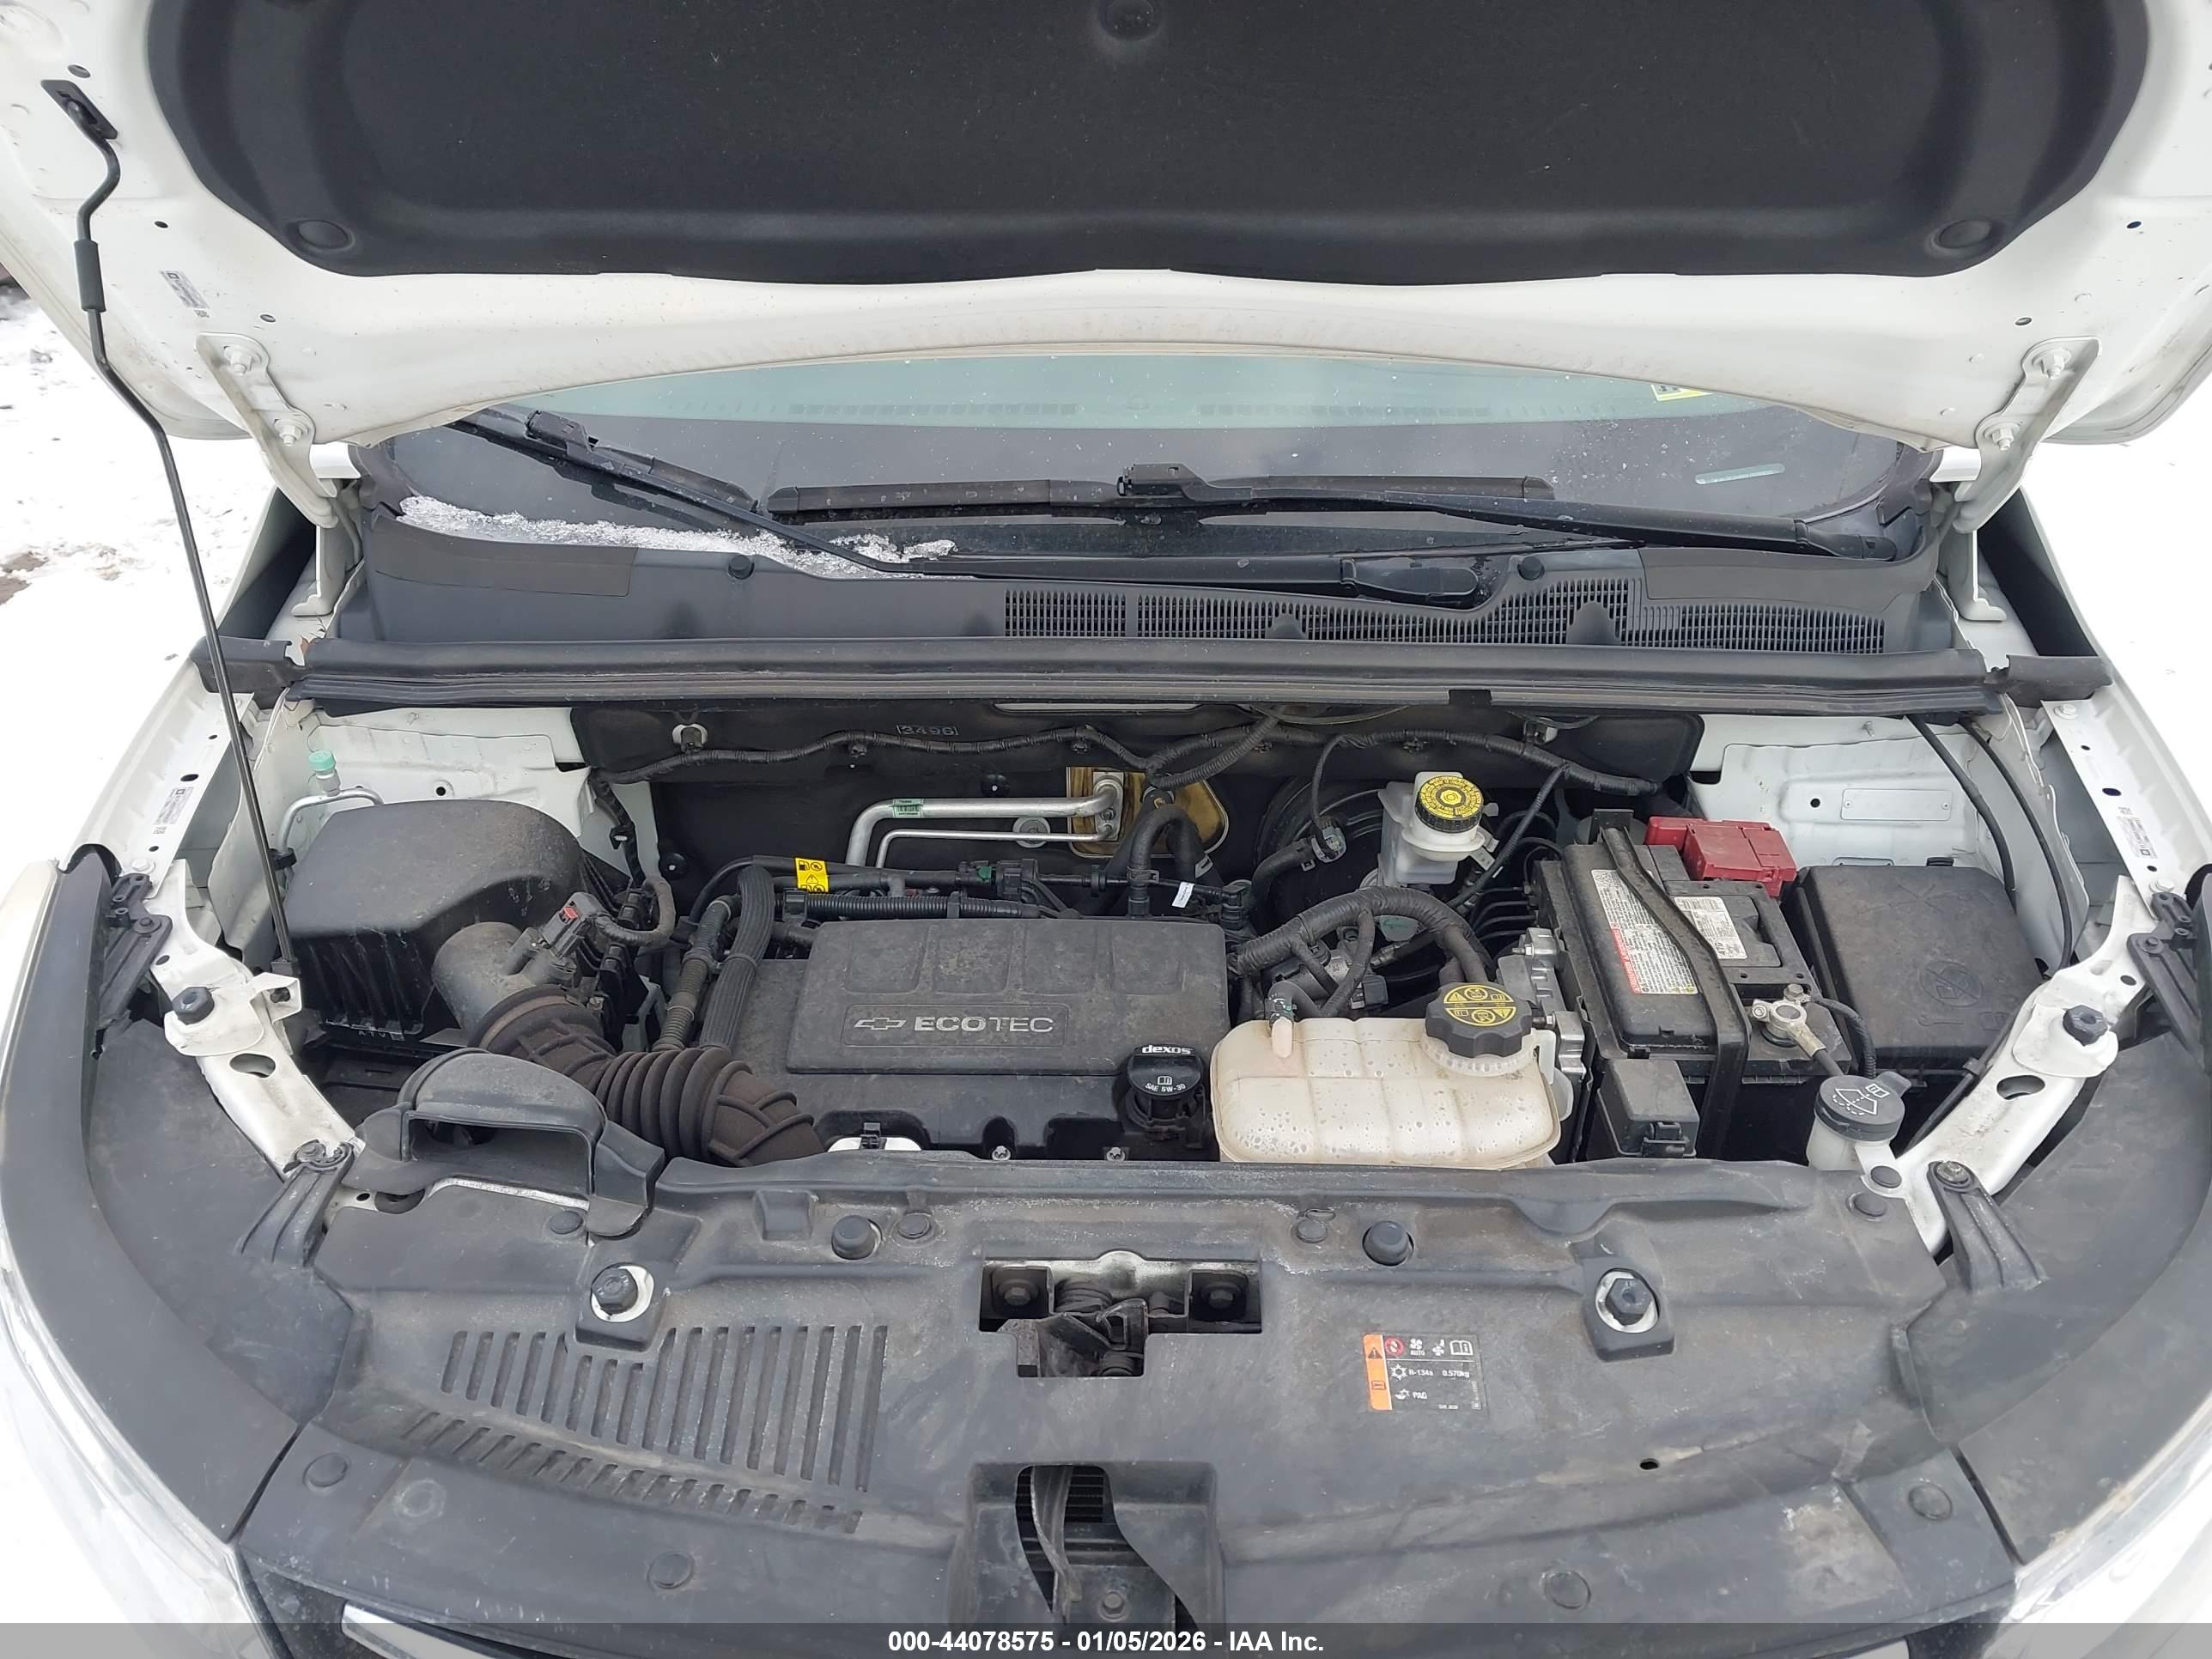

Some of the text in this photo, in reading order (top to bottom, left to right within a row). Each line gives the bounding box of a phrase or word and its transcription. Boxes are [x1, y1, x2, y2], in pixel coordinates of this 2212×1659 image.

[914, 1016, 1054, 1033] ECOTEC
[1141, 1044, 1192, 1054] dexos
[1145, 1083, 1186, 1092] SAE 5W-30
[1413, 1391, 1428, 1400] PAG
